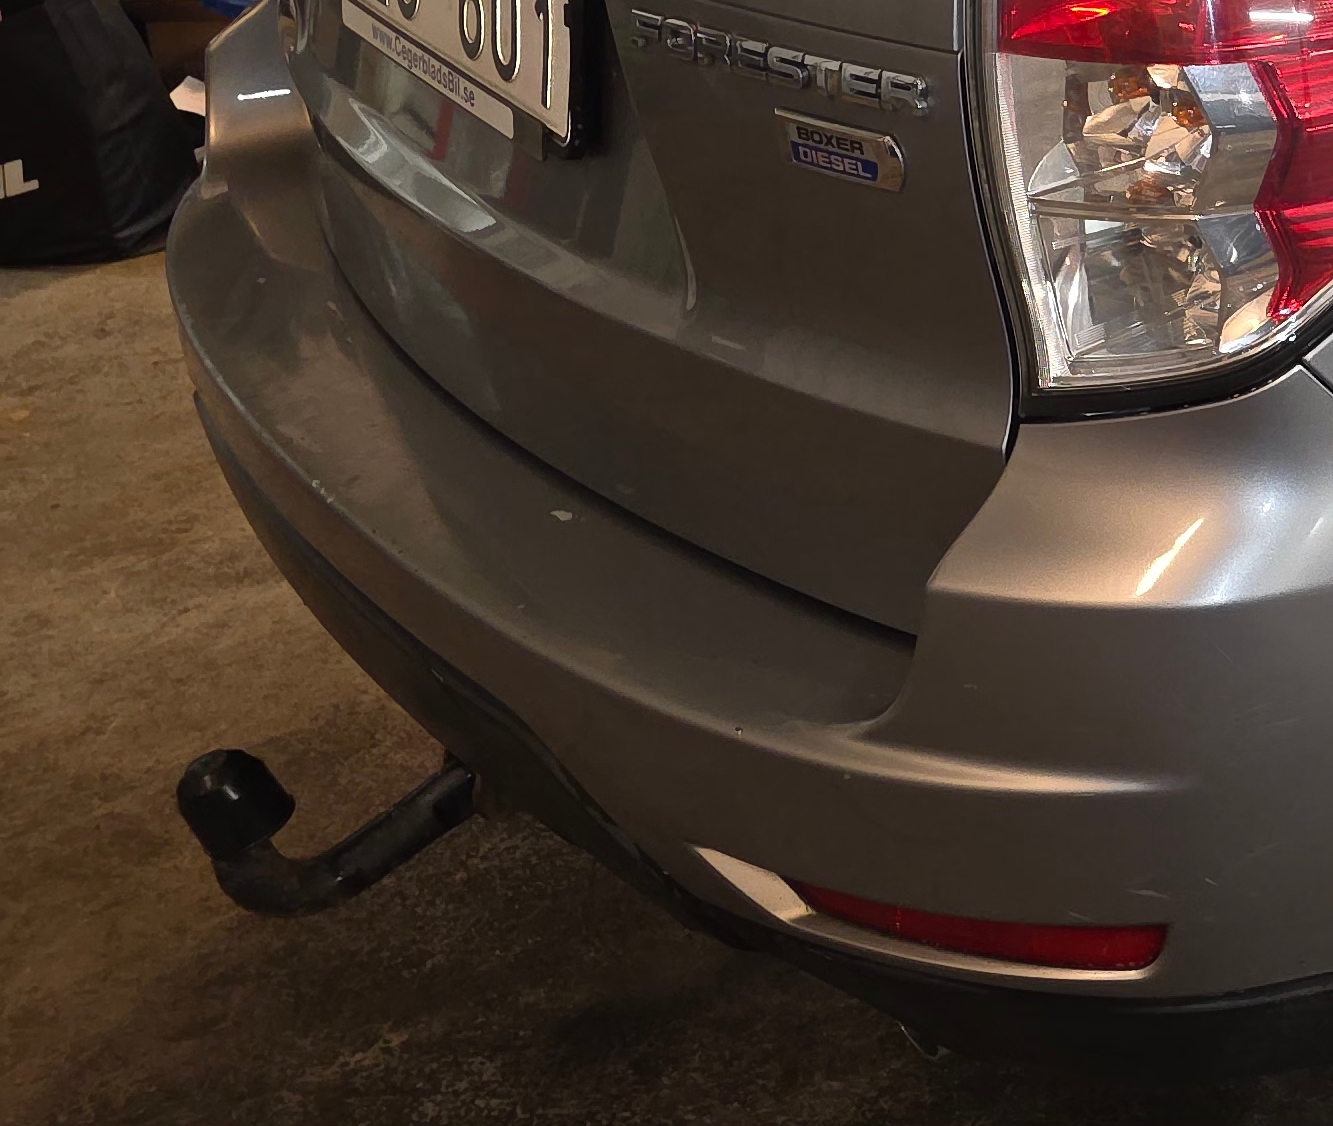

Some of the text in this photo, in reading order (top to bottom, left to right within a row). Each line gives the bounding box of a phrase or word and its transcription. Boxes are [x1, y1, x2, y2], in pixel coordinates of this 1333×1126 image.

[631, 8, 929, 110] FORESTER
[795, 125, 865, 156] BOXER
[0, 159, 39, 200] L
[798, 145, 873, 178] DIESEL
